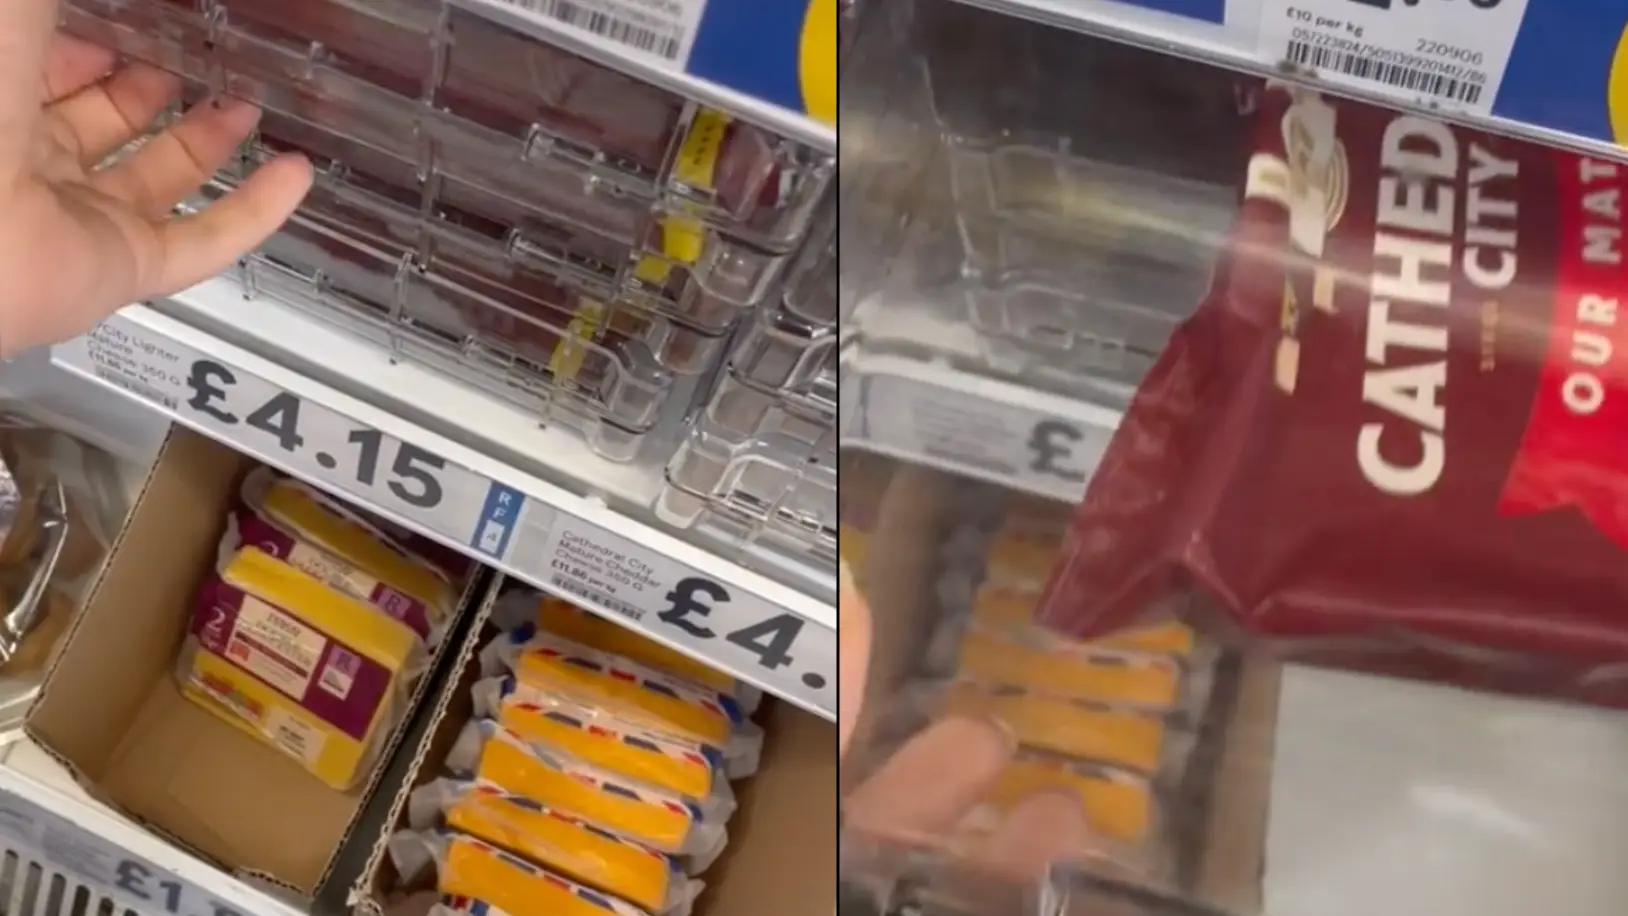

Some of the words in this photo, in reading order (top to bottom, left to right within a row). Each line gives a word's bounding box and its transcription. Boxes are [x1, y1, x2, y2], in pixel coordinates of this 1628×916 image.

[1286, 6, 1312, 23] £10
[1315, 16, 1343, 29] per
[1415, 36, 1484, 66] 220906
[1462, 142, 1519, 290] CITY
[133, 335, 179, 362] Lighter
[1561, 293, 1618, 415] OUR
[187, 359, 447, 508] £4.15
[556, 548, 602, 574] Cheese
[558, 539, 604, 564] Mature
[606, 559, 662, 588] Cheddar
[563, 529, 627, 561] Cathedral
[627, 557, 654, 576] City
